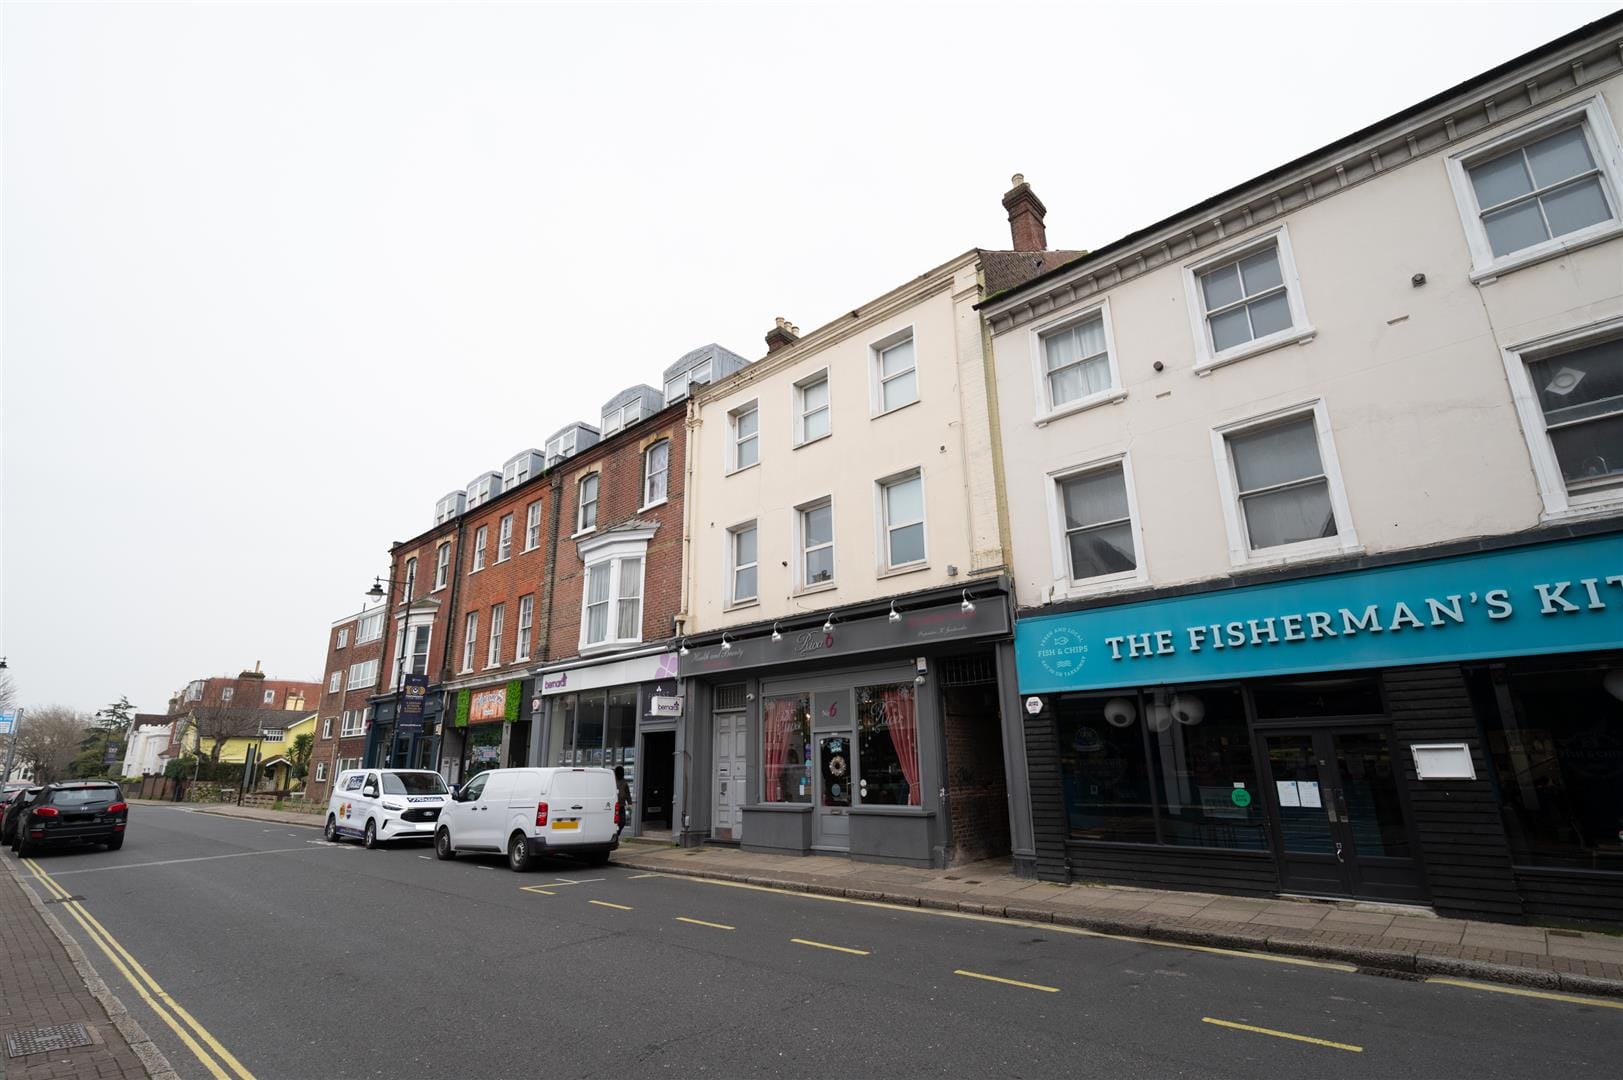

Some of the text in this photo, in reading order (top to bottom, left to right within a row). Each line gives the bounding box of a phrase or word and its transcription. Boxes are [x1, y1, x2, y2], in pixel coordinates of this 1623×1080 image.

[1105, 630, 1175, 659] THE
[1187, 589, 1513, 651] FISHERMAN'S
[1037, 648, 1056, 657] FISH
[1064, 645, 1088, 655] CHIPS
[828, 702, 838, 718] 6
